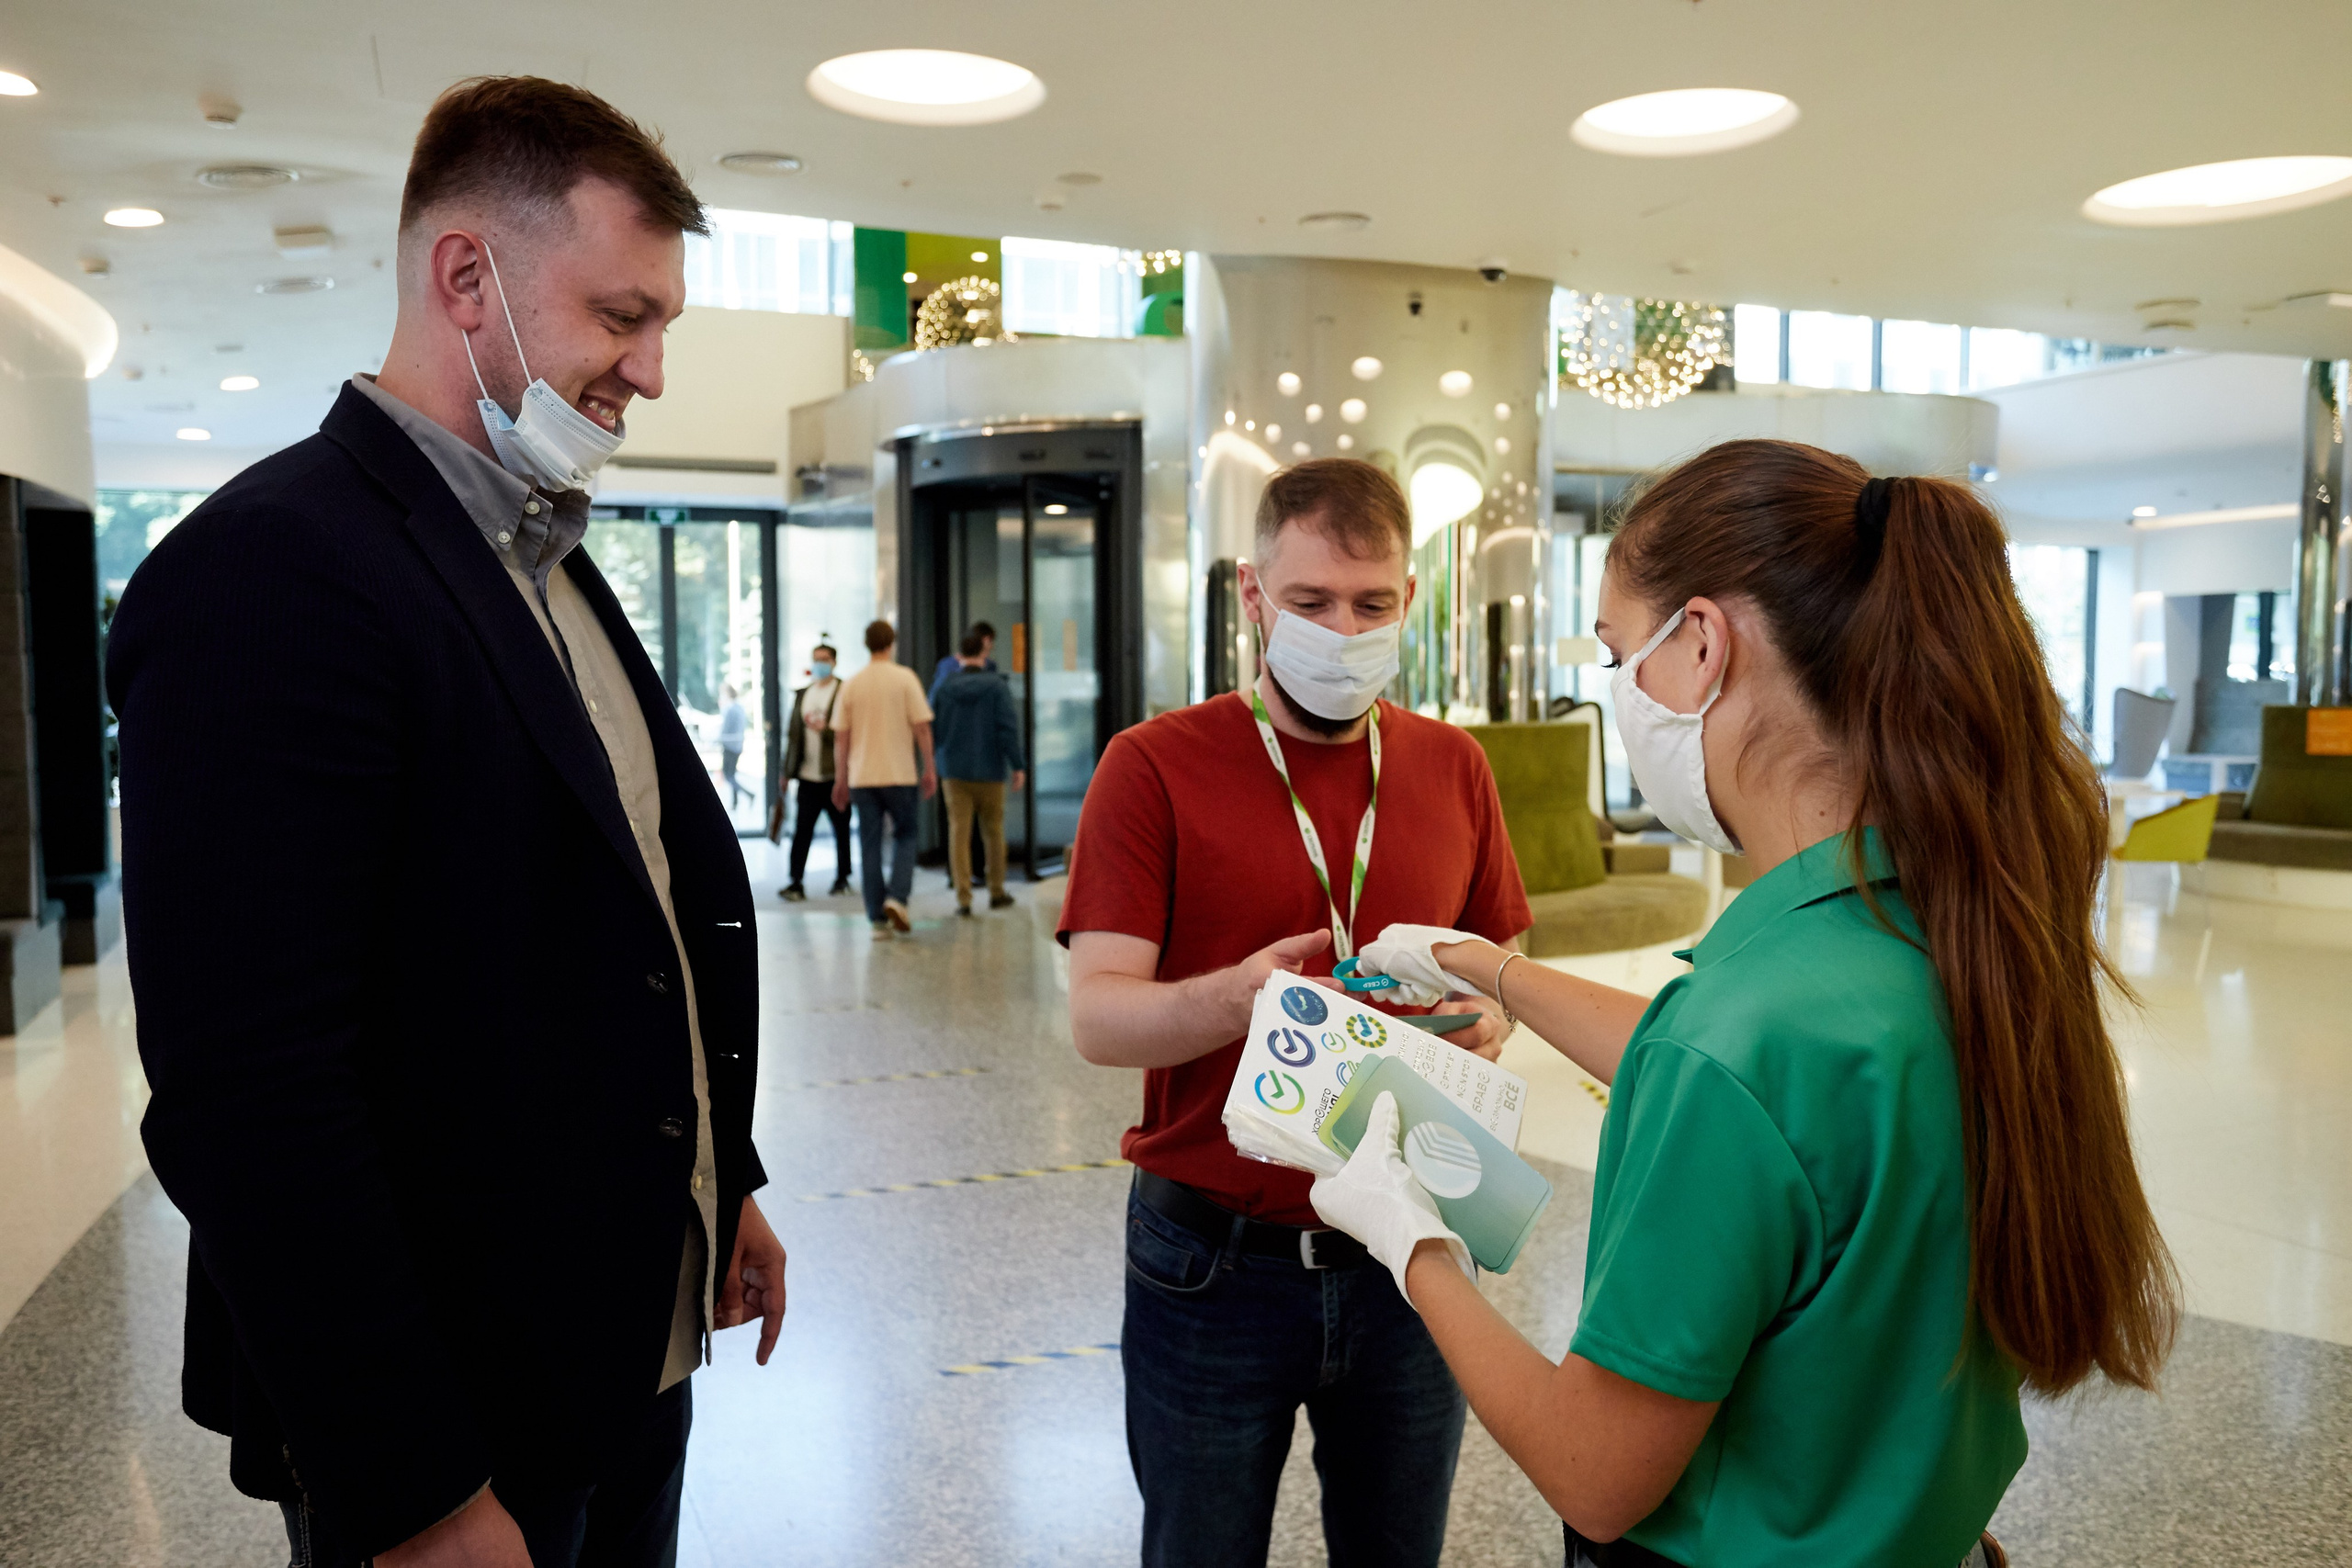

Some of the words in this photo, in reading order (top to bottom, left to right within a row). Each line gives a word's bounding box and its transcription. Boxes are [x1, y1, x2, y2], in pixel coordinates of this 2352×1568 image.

[1397, 1031, 1410, 1059] ТЛИЧНО!
[1413, 1038, 1426, 1073] ОПРОБУЙ
[1461, 1059, 1470, 1078] STOP
[1456, 1078, 1467, 1099] NON
[1503, 1080, 1520, 1111] ВСЁ
[1311, 1088, 1331, 1135] ХОРОШЕГО
